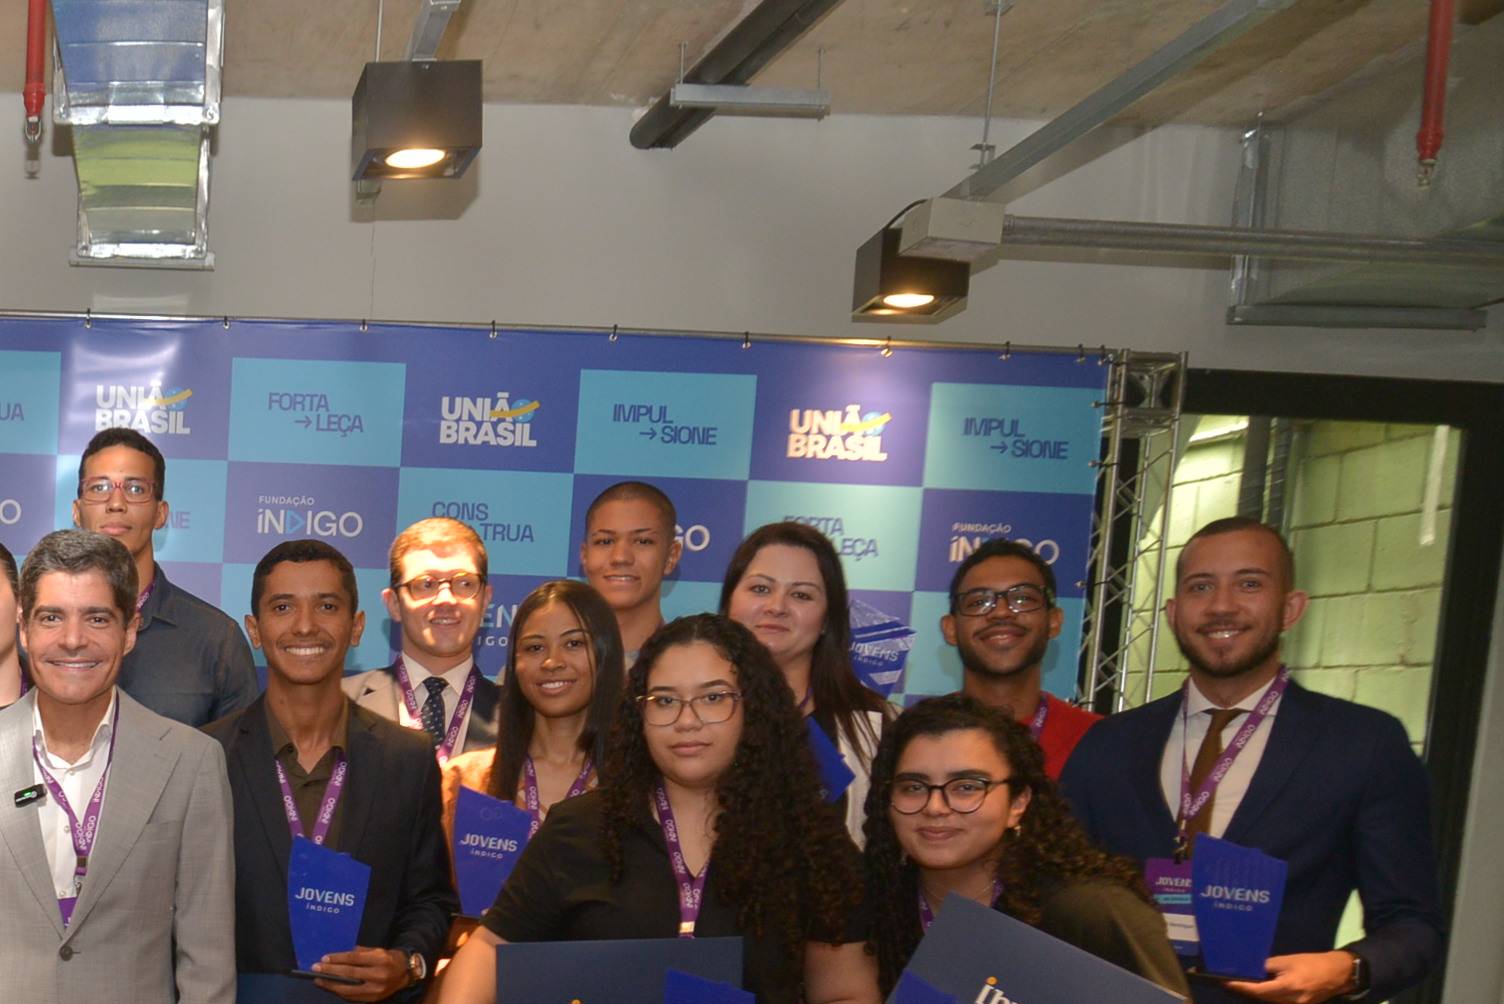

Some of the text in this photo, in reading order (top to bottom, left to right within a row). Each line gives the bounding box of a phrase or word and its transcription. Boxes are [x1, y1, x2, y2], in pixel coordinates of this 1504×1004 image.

[268, 392, 330, 412] FORTA
[96, 409, 191, 435] BRASIL
[613, 403, 673, 424] IMPUL
[316, 414, 364, 437] LEÇA
[439, 420, 537, 447] BRASIL
[660, 425, 718, 446] SIONE
[963, 417, 1026, 438] IMPUL
[786, 434, 888, 462] BRASIL
[1011, 439, 1069, 460] SIONE
[258, 495, 315, 506] FUNDAÇÃO
[479, 523, 534, 542] TRUA
[952, 521, 1012, 534] FUNDAÇÃO
[460, 833, 518, 852] JOVENS
[295, 887, 355, 907] JOVENS
[1200, 885, 1271, 903] JOVENS
